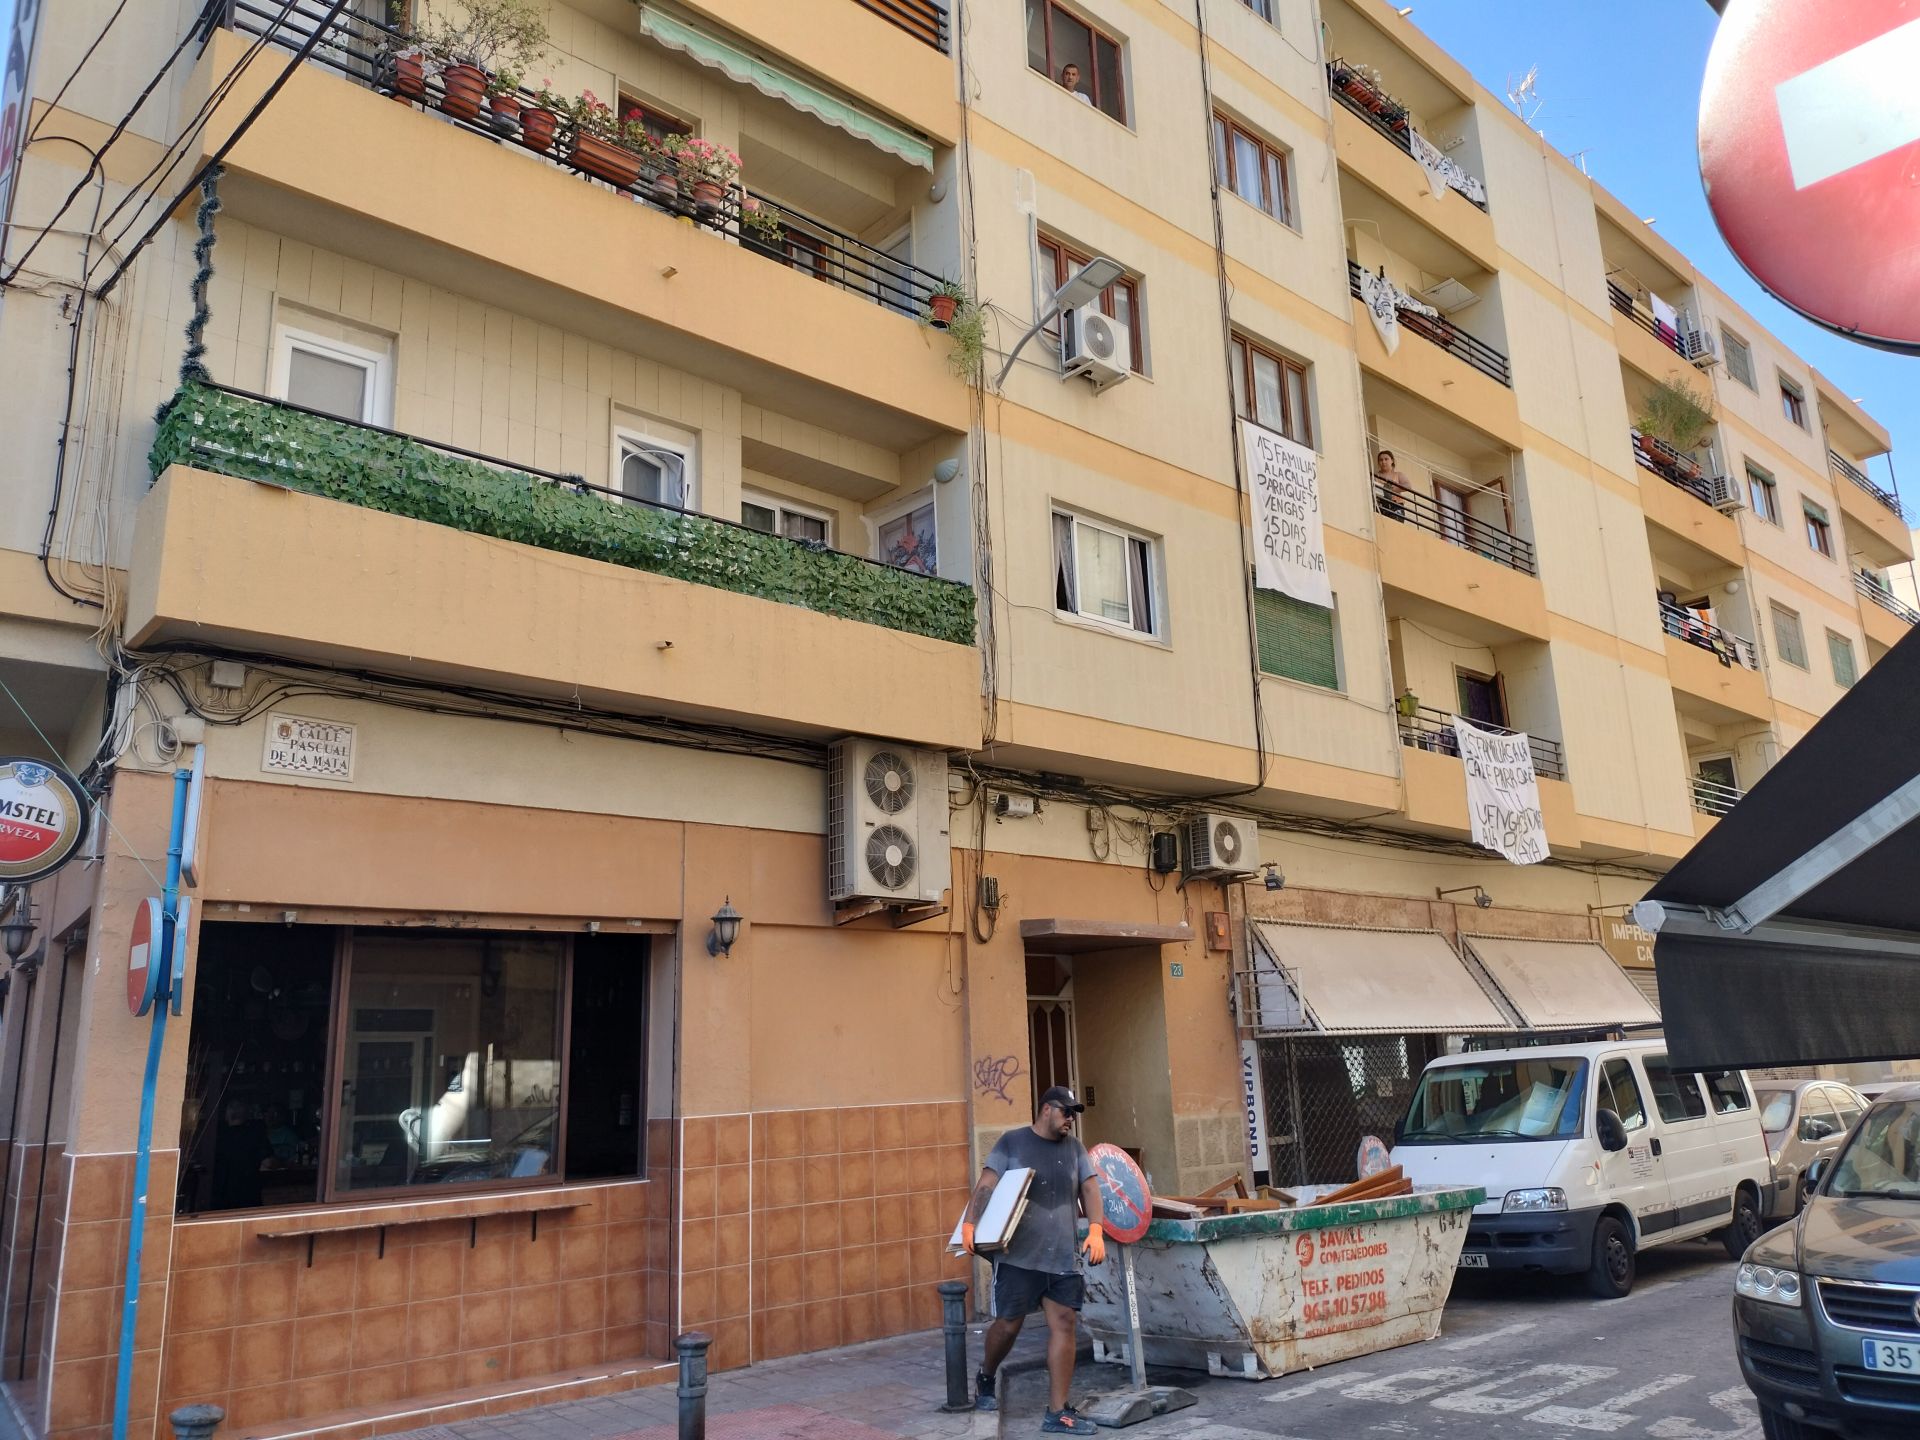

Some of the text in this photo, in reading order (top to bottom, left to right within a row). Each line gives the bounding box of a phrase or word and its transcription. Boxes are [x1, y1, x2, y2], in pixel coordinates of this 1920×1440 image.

[1257, 435, 1316, 480] 15 FAMILIAS
[1264, 514, 1307, 545] 15 DIAS
[299, 728, 342, 742] CALLE
[271, 750, 347, 769] DE LA MATA
[290, 739, 349, 757] PASCUAL
[0, 799, 56, 827] MSTEL
[0, 824, 41, 841] RVEZA
[1173, 965, 1182, 976] 23
[1243, 1056, 1259, 1157] VIPBOND
[1320, 1226, 1365, 1249] SAVALL
[1319, 1242, 1388, 1265] CONTENEDORES
[1465, 1255, 1483, 1266] CMT
[1336, 1267, 1385, 1292] PEDIDOS
